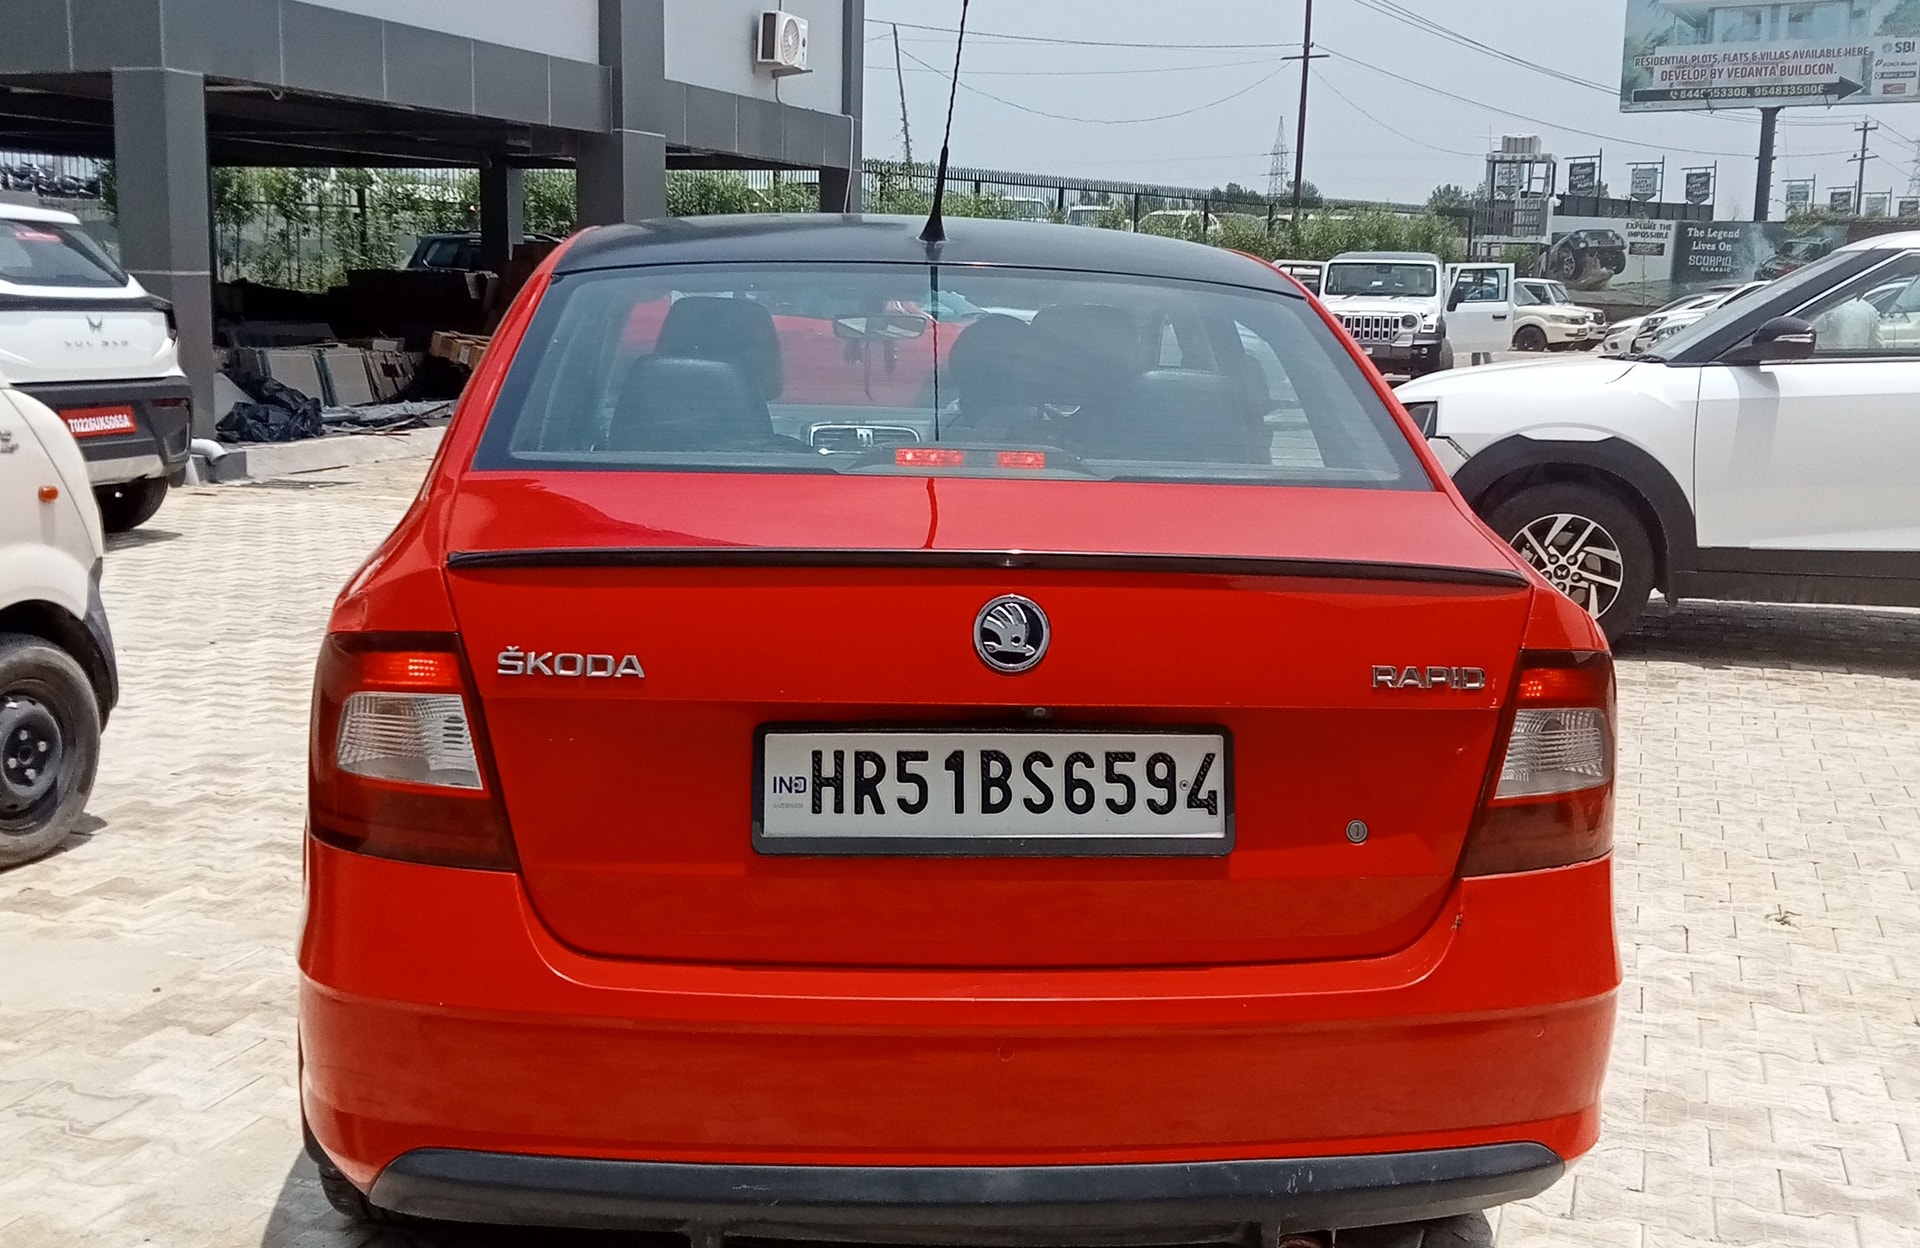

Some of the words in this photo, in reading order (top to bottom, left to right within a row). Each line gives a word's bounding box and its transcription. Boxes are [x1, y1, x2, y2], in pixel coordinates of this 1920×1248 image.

[1895, 41, 1915, 53] SBI
[1634, 55, 1688, 67] RESIDENTIAL
[1691, 53, 1720, 64] PLOTS,
[1722, 52, 1749, 62] FLATS
[1751, 51, 1758, 61] &
[1760, 50, 1790, 60] VILLAS
[1792, 47, 1842, 59] AVAILABLE
[1844, 46, 1869, 57] HERE
[1661, 69, 1707, 81] DEVELOP
[1710, 68, 1724, 79] BY
[1727, 65, 1776, 79] VEDANTA
[1779, 63, 1837, 77] BUILDCON.
[1659, 223, 1672, 231] THE
[1687, 227, 1705, 237] The
[1707, 228, 1740, 239] Legend
[1628, 231, 1669, 239] IMPOSSIBLE
[1692, 240, 1716, 251] Lives
[1718, 242, 1732, 251] On
[1688, 255, 1732, 267] SCORPIO
[497, 646, 645, 678] ŠKODA
[1371, 665, 1485, 689] RAPID
[773, 776, 807, 794] IND
[811, 750, 1218, 816] HR51BS6594
